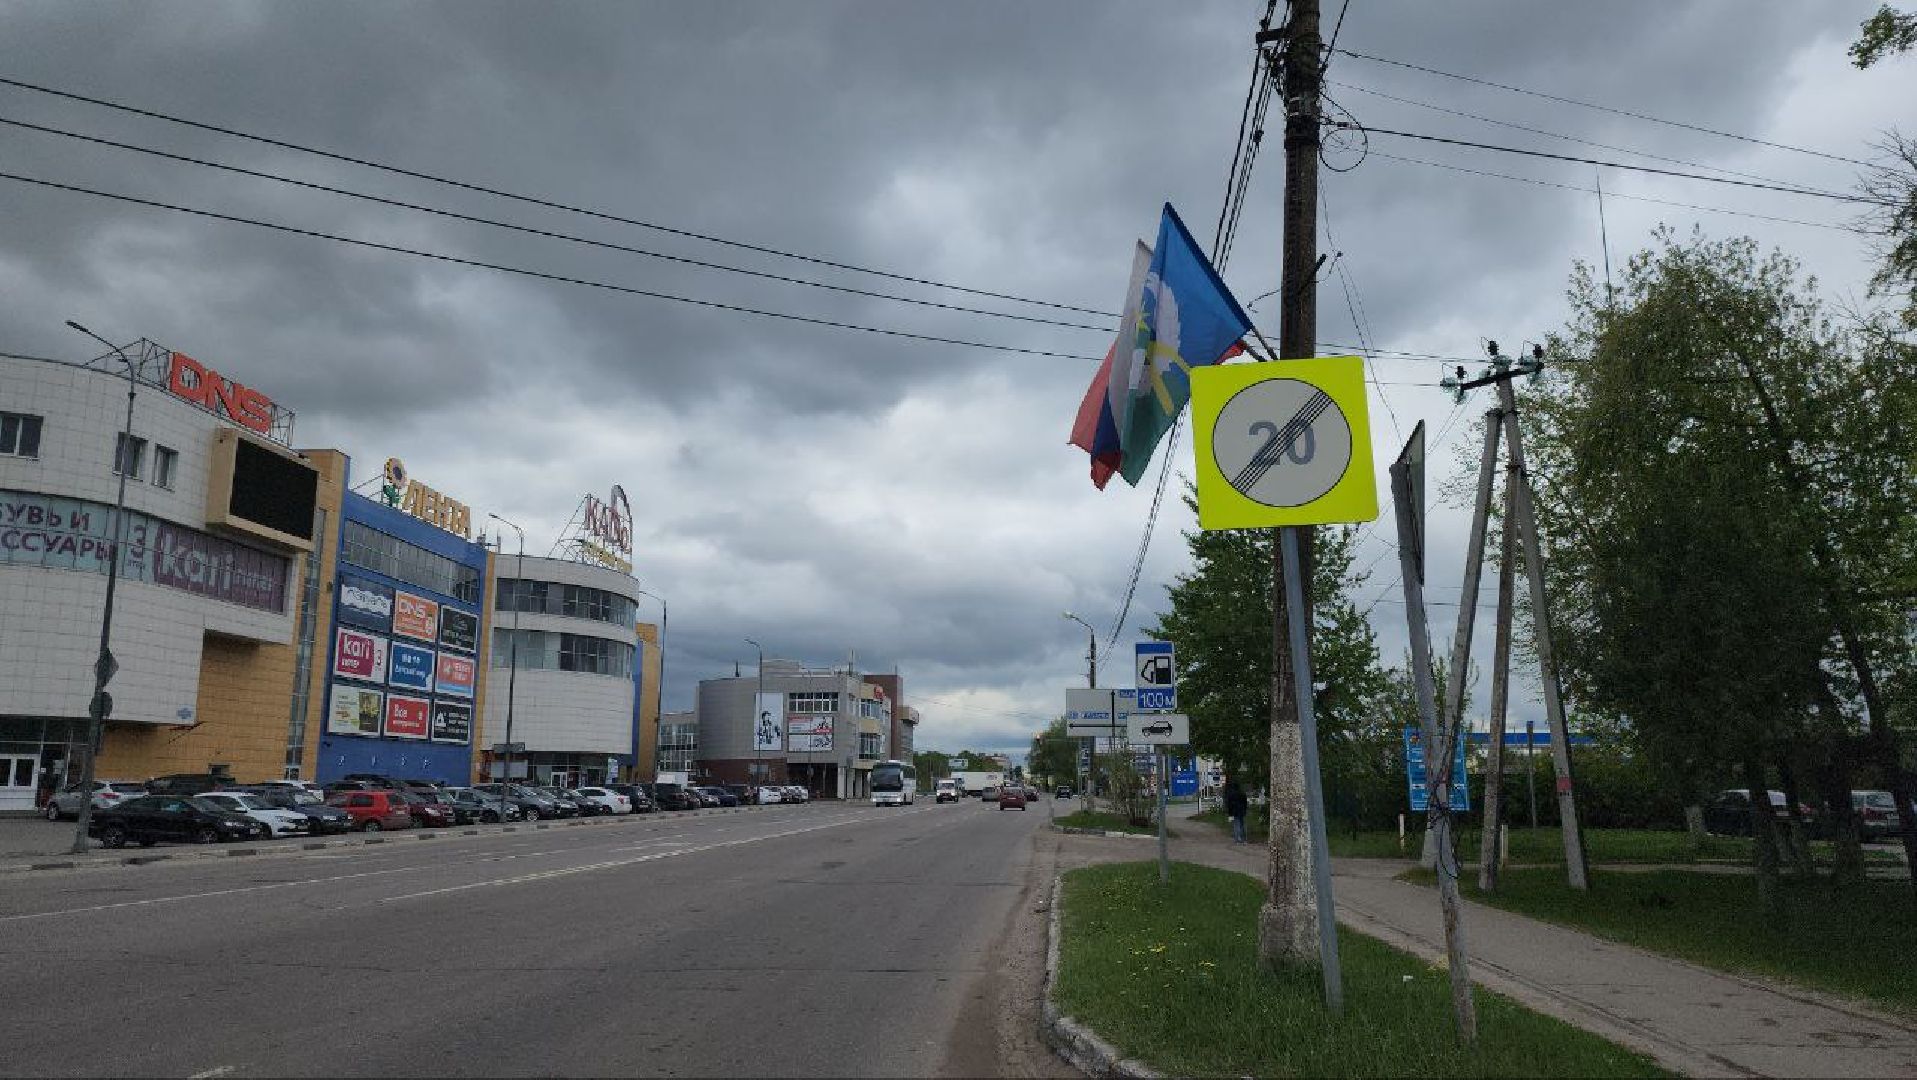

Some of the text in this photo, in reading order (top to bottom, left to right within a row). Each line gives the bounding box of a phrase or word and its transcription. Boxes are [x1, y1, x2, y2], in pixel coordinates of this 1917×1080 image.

[170, 352, 273, 434] DNS
[1248, 420, 1317, 466] 20
[401, 478, 472, 540] ЛЕНТА
[398, 598, 426, 619] DNS
[343, 634, 370, 660] kari
